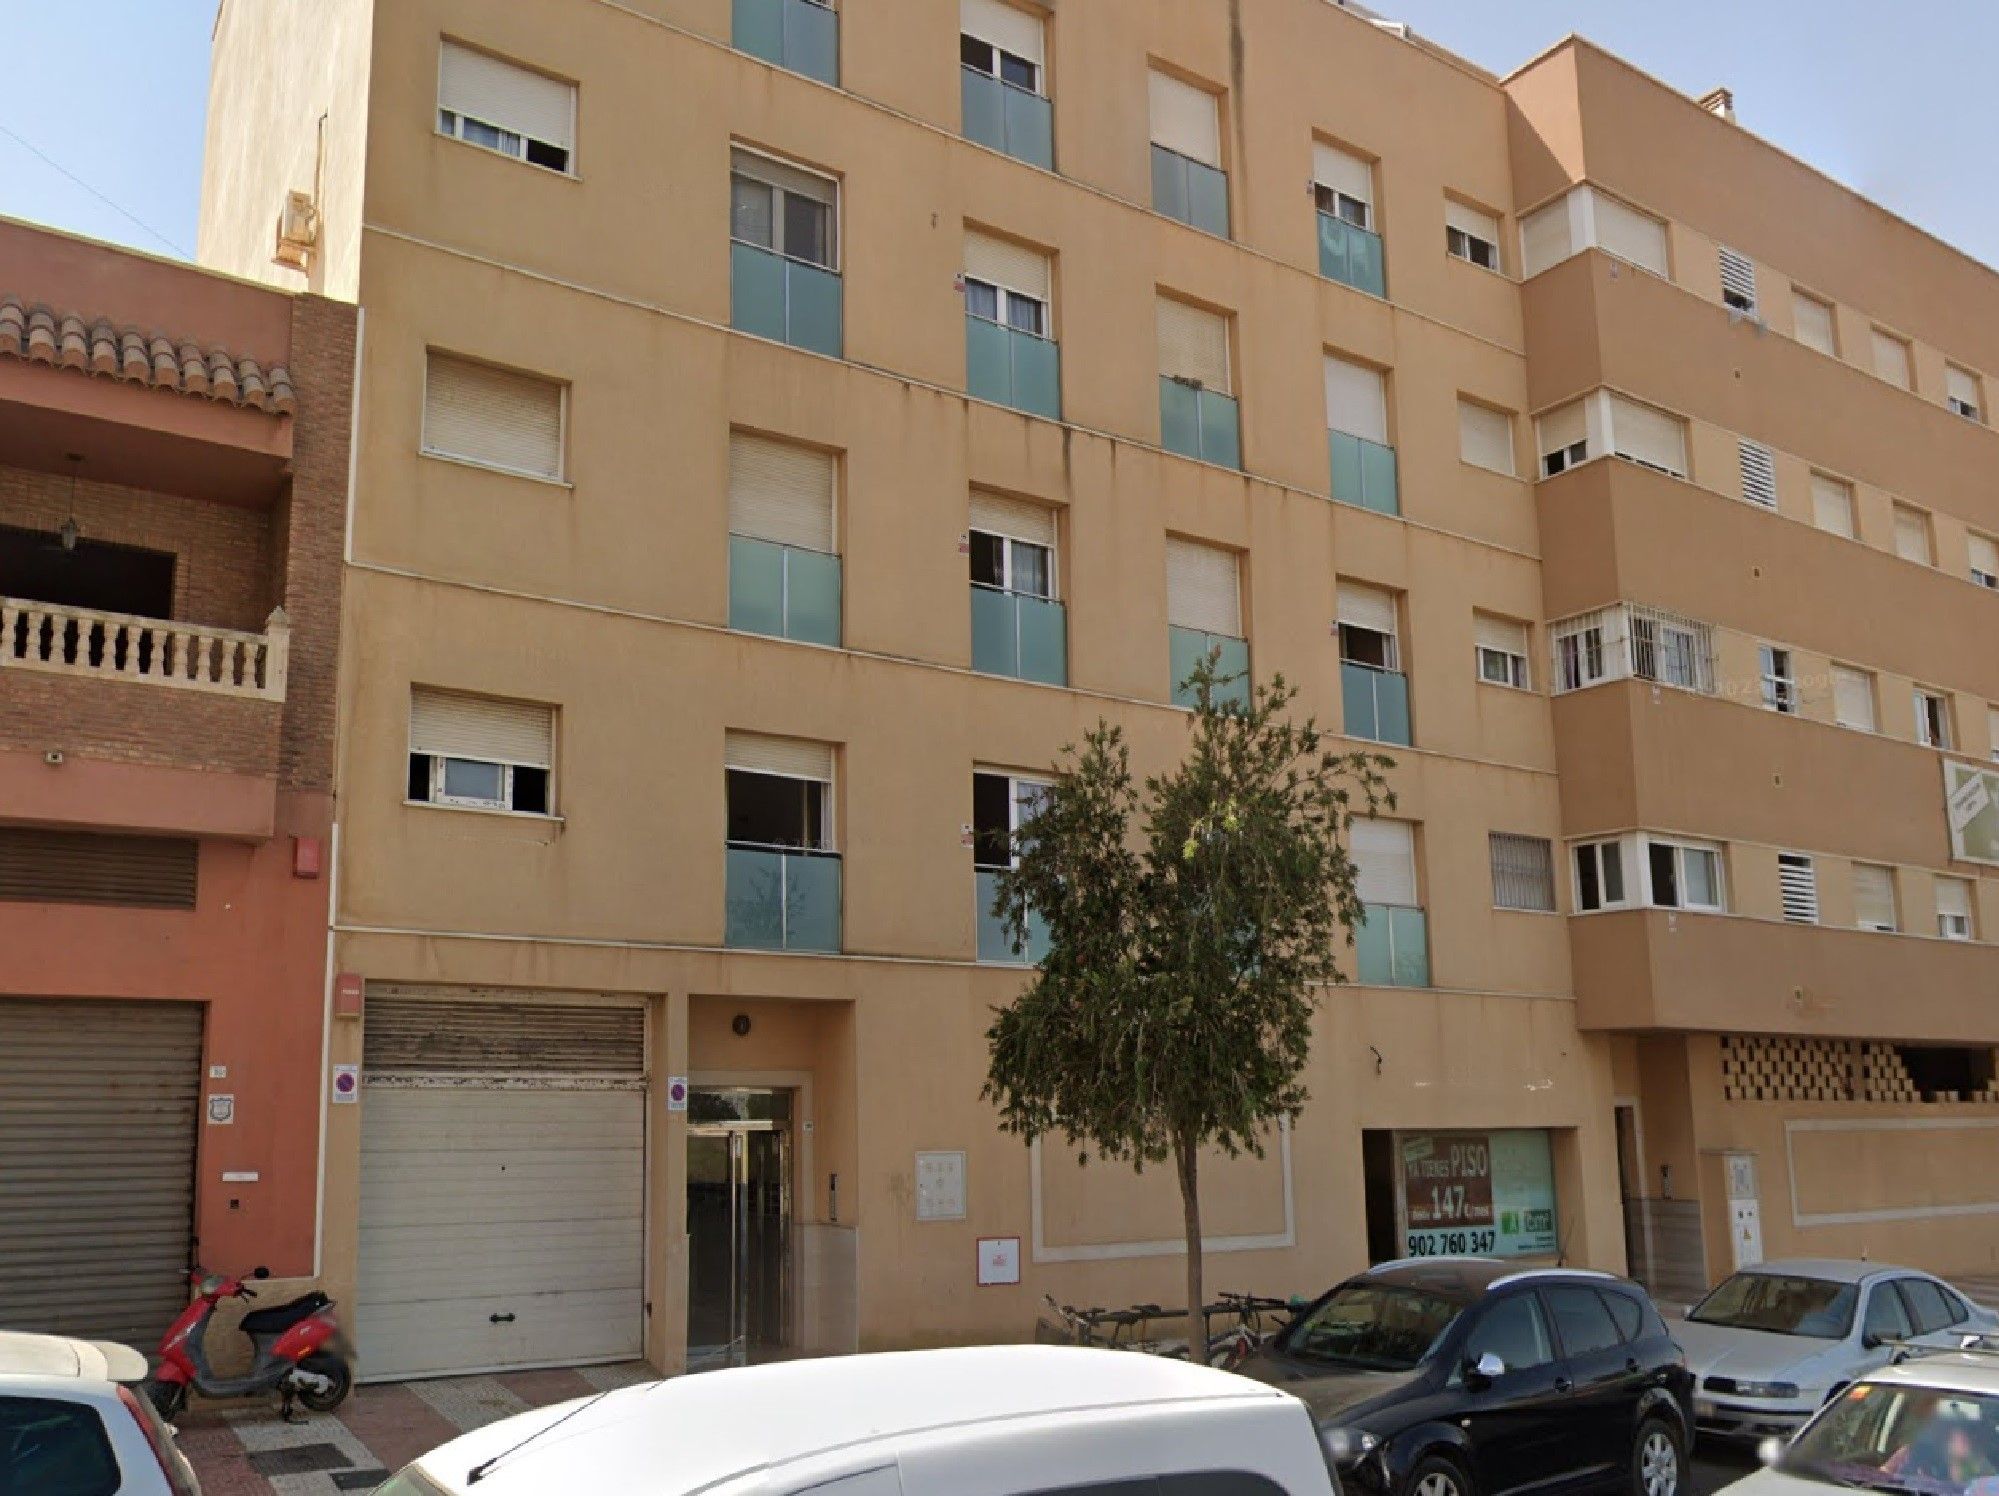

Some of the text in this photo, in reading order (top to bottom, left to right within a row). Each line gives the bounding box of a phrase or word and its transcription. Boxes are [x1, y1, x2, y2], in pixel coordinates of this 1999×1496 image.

[1451, 1144, 1488, 1178] PISO
[1431, 1185, 1465, 1219] 147
[1408, 1230, 1496, 1257] 902 760 347
